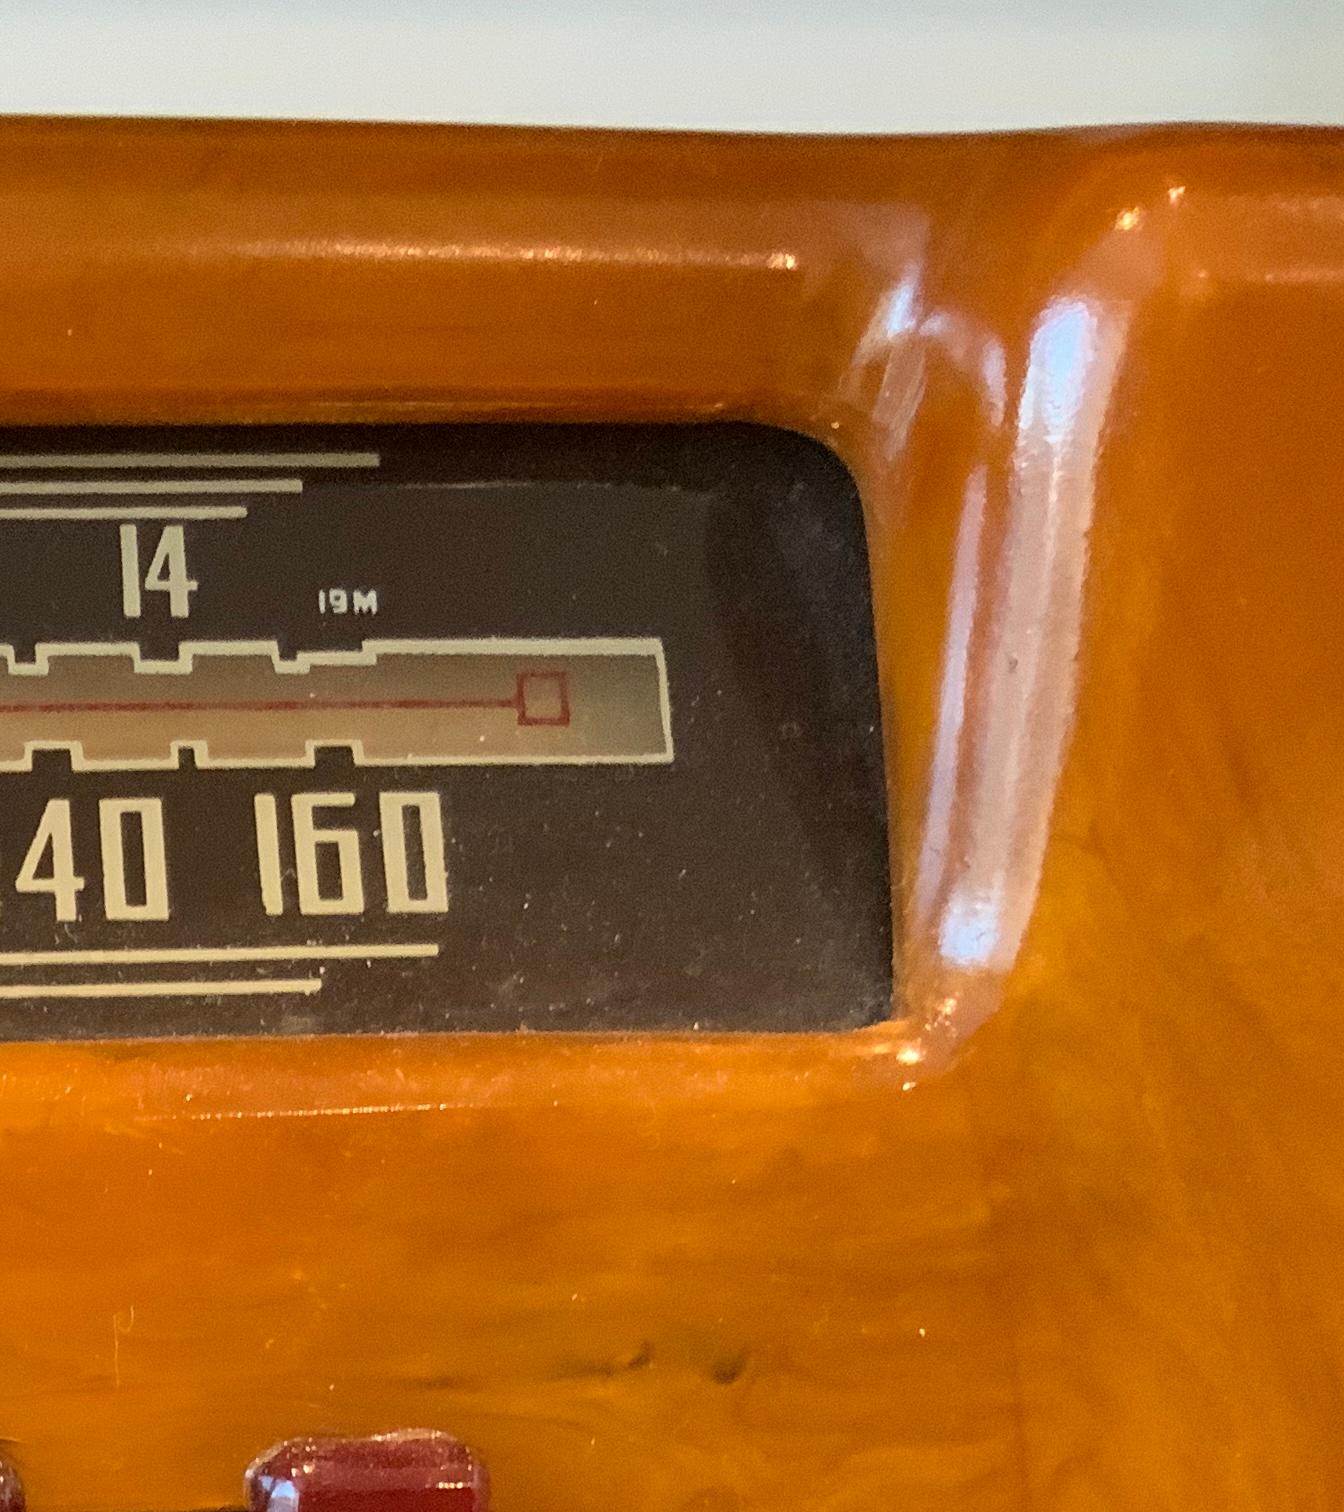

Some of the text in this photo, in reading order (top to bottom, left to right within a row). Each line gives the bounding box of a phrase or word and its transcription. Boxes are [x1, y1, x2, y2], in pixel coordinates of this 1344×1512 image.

[119, 524, 198, 618] 14
[317, 589, 379, 615] 19M
[254, 791, 450, 916] 160
